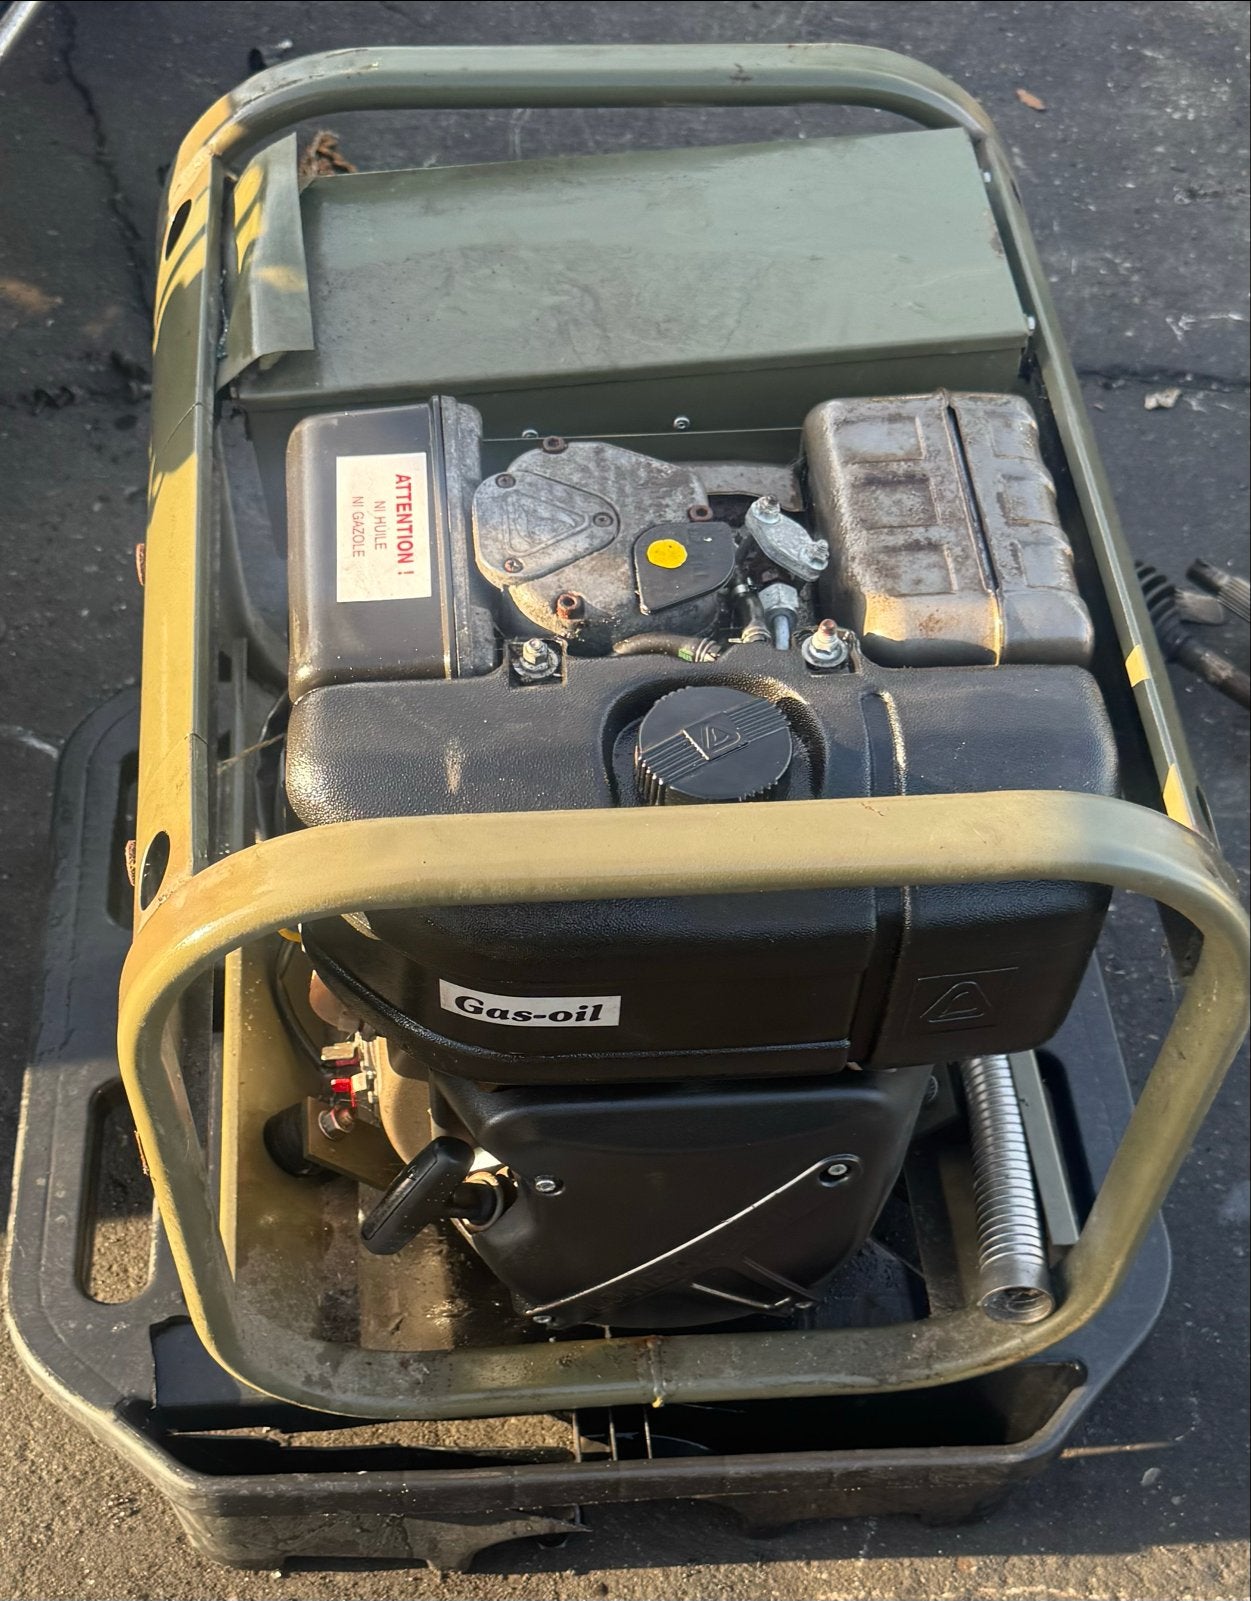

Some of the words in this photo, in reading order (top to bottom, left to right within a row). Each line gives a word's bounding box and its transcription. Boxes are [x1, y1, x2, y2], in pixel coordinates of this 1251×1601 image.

[352, 496, 364, 507] NI
[374, 501, 386, 512] NI
[374, 516, 387, 550] HUILE
[395, 474, 414, 564] ATTENTION
[352, 511, 365, 558] GAZOLE
[454, 995, 603, 1022] Gas-oil
